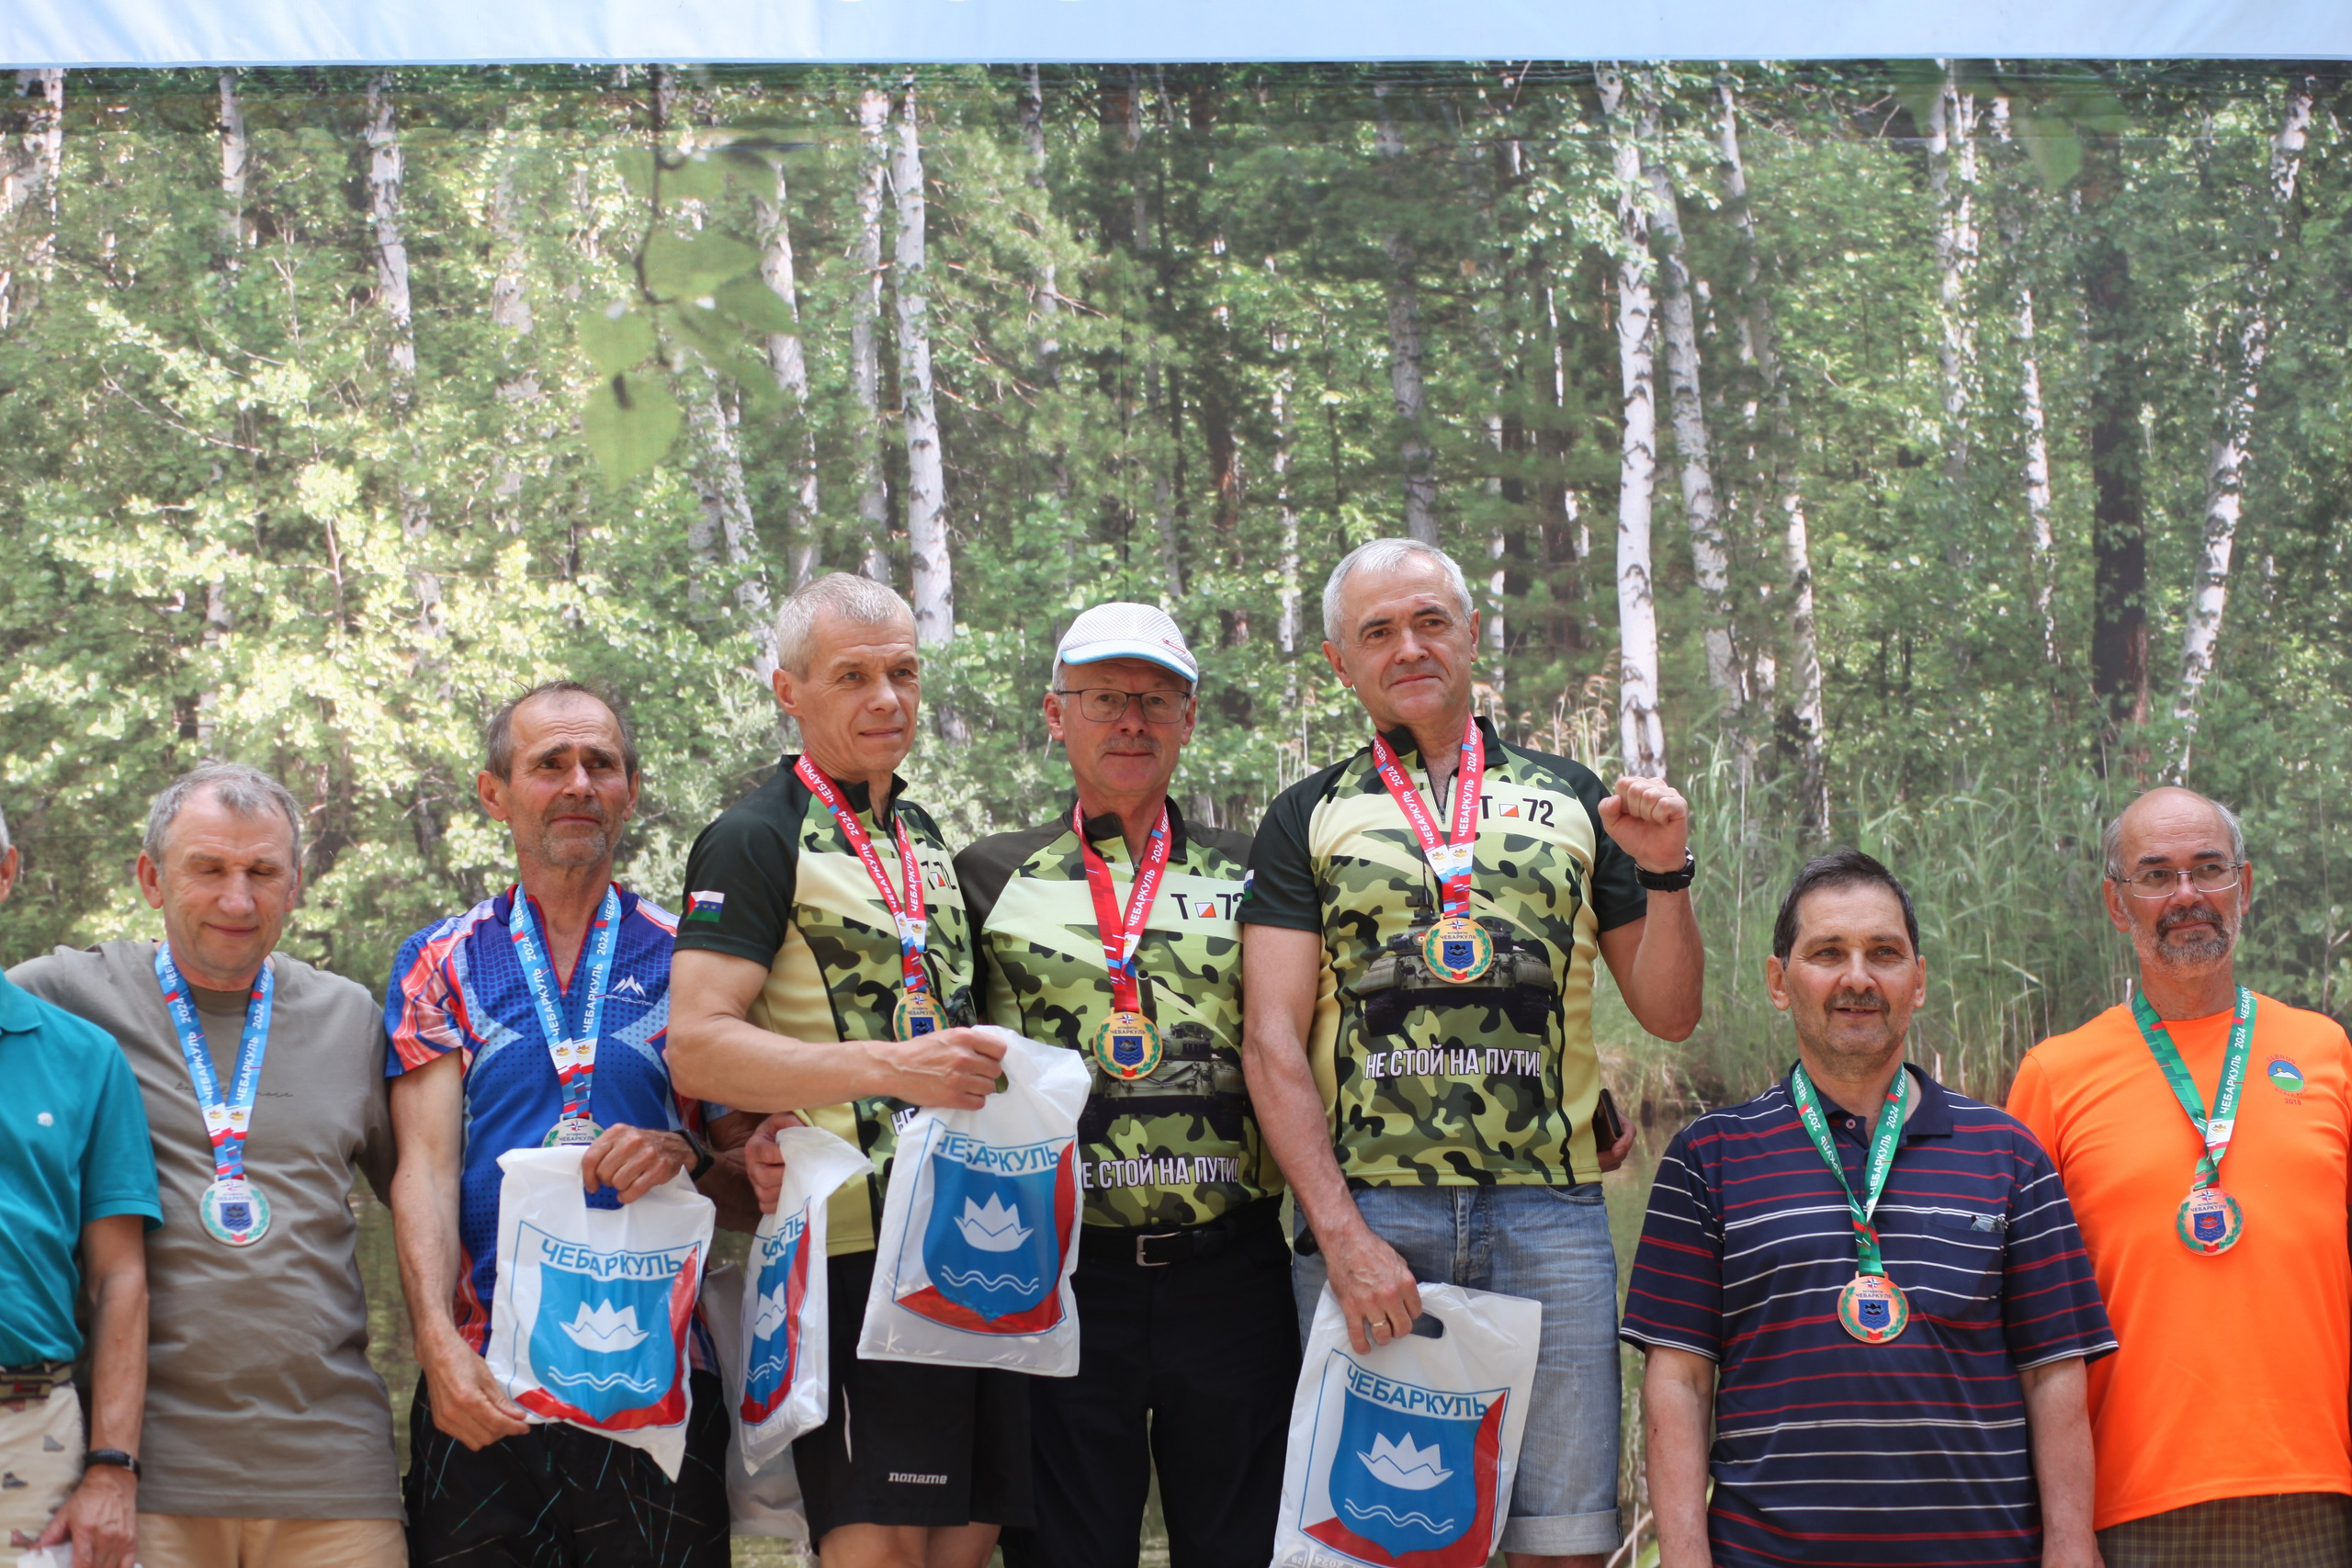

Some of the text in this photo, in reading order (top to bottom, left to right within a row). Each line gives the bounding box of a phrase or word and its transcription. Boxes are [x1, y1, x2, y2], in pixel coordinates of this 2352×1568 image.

[1385, 765, 1435, 845] ЧЕБАРКУЛЬ 2024
[1458, 751, 1477, 837] ЧЕБАРКУЛЬ 2024
[1522, 797, 1555, 829] 72
[838, 810, 897, 908] ЧЕБАРКУЛЬ 2024
[904, 851, 919, 912] ЧЕБАРКУЛЬ
[1128, 840, 1165, 927] ЧЕБАРКУЛЬ 2024
[521, 935, 560, 1036] ЧЕБАРКУЛЬ 2024
[582, 931, 610, 1033] ЧЕБАРКУЛЬ 2024
[175, 998, 214, 1100] ЧЕБАРКУЛЬ 2024
[235, 1003, 265, 1101] ЧЕБАРКУЛЬ 2024
[1364, 1043, 1541, 1079] НЕ СТОЙ НА ПУТИ!
[2220, 1027, 2246, 1114] ЧЕБАРКУЛЬ 2024
[2266, 1053, 2296, 1065] ELBRUS
[1804, 1106, 1822, 1132] 2024
[1870, 1104, 1900, 1195] ЧЕБАРКУЛЬ 2024
[1081, 1153, 1239, 1189] Е СТОЙ НА ПУТИ!
[542, 1238, 684, 1278] ЧЕБАРКУЛЬ
[1347, 1363, 1488, 1418] ЧЕБАРКУЛЬ
[888, 1472, 948, 1484] noname
